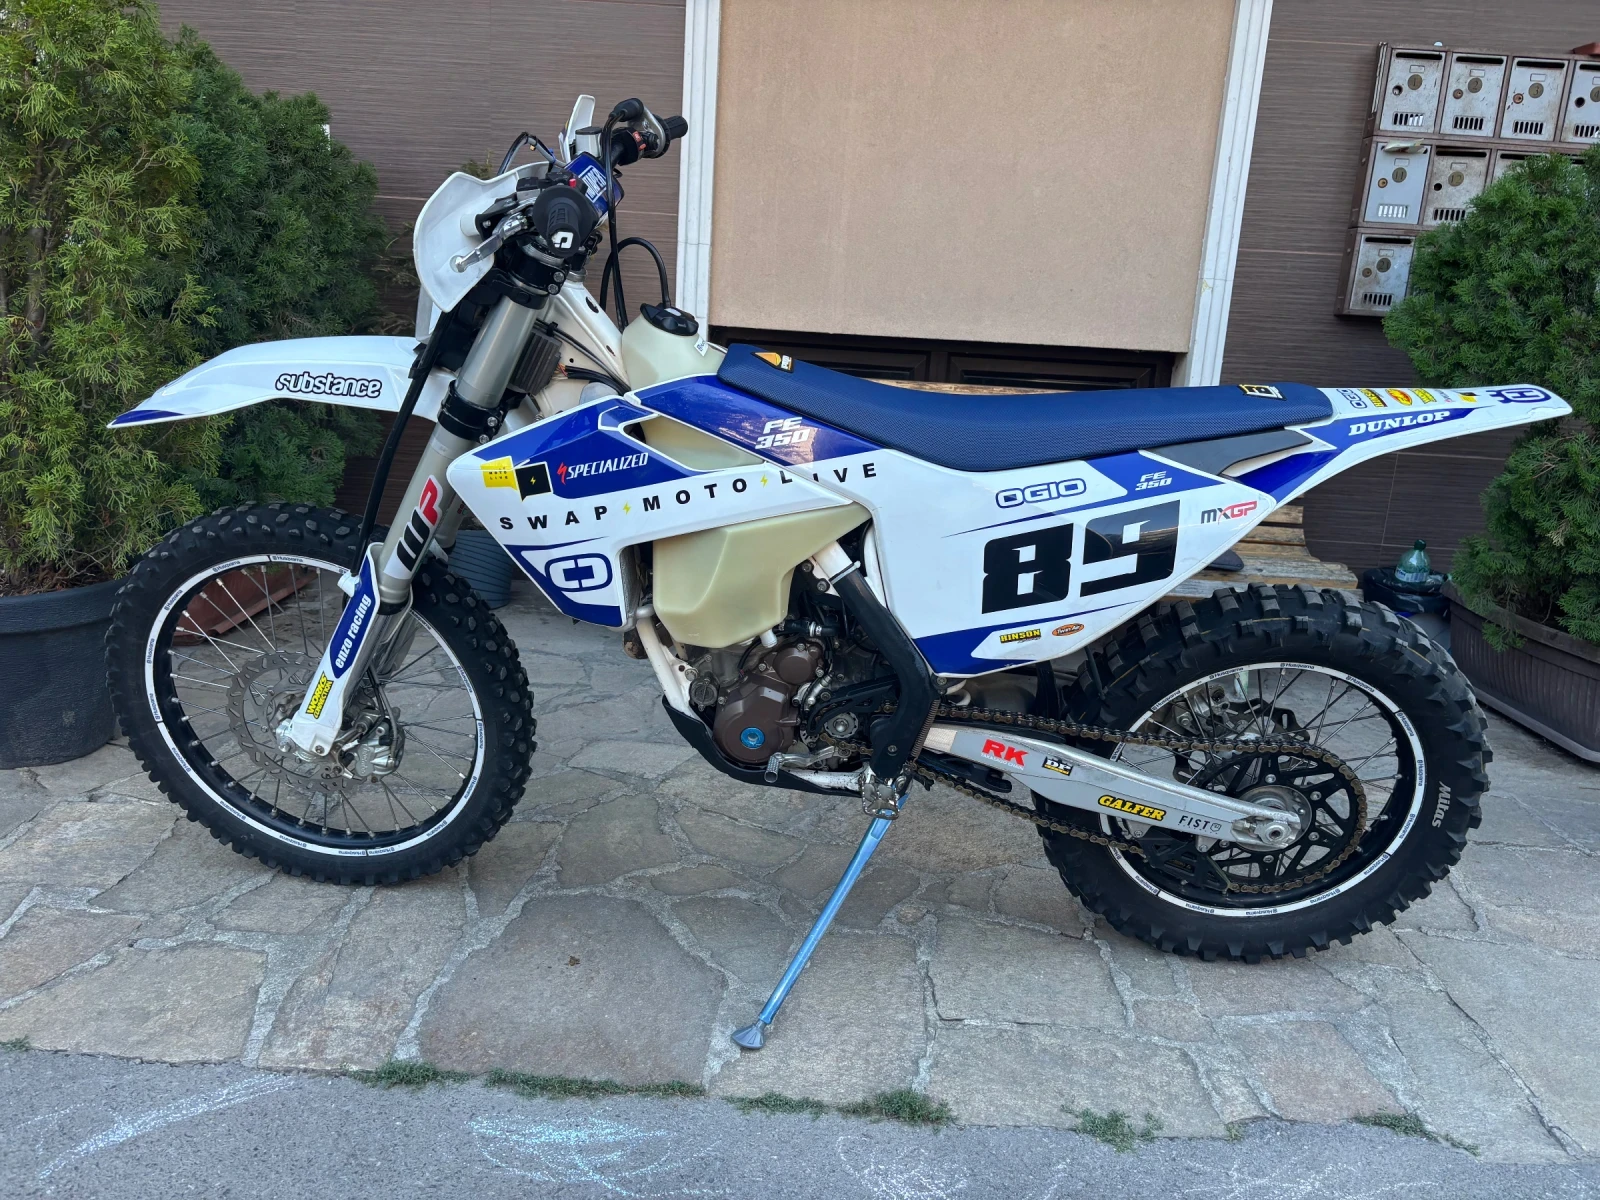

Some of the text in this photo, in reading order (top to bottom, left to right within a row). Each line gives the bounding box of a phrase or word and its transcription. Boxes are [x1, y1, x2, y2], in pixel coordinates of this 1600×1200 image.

[275, 371, 382, 398] substance
[763, 416, 803, 435] FE
[1348, 410, 1450, 436] DUNLOP
[755, 428, 811, 450] 350
[566, 452, 649, 480] SPECIALIZED
[1141, 470, 1167, 482] FE
[500, 463, 877, 530] SWAP MOTO LIVE
[996, 478, 1087, 509] OGIO
[1135, 477, 1173, 492] 350
[982, 499, 1181, 614] 89
[335, 594, 372, 669] enzo racing
[1000, 629, 1041, 643] HINSON
[1214, 667, 1244, 678] Husqvarna
[1286, 662, 1315, 670] Husqvarna
[306, 672, 327, 714] WORKS
[1350, 677, 1375, 693] Husqvarna
[982, 739, 1029, 767] RK
[1098, 795, 1166, 821] GALFER
[1432, 781, 1452, 828] Mitas
[1179, 815, 1210, 830] FIST
